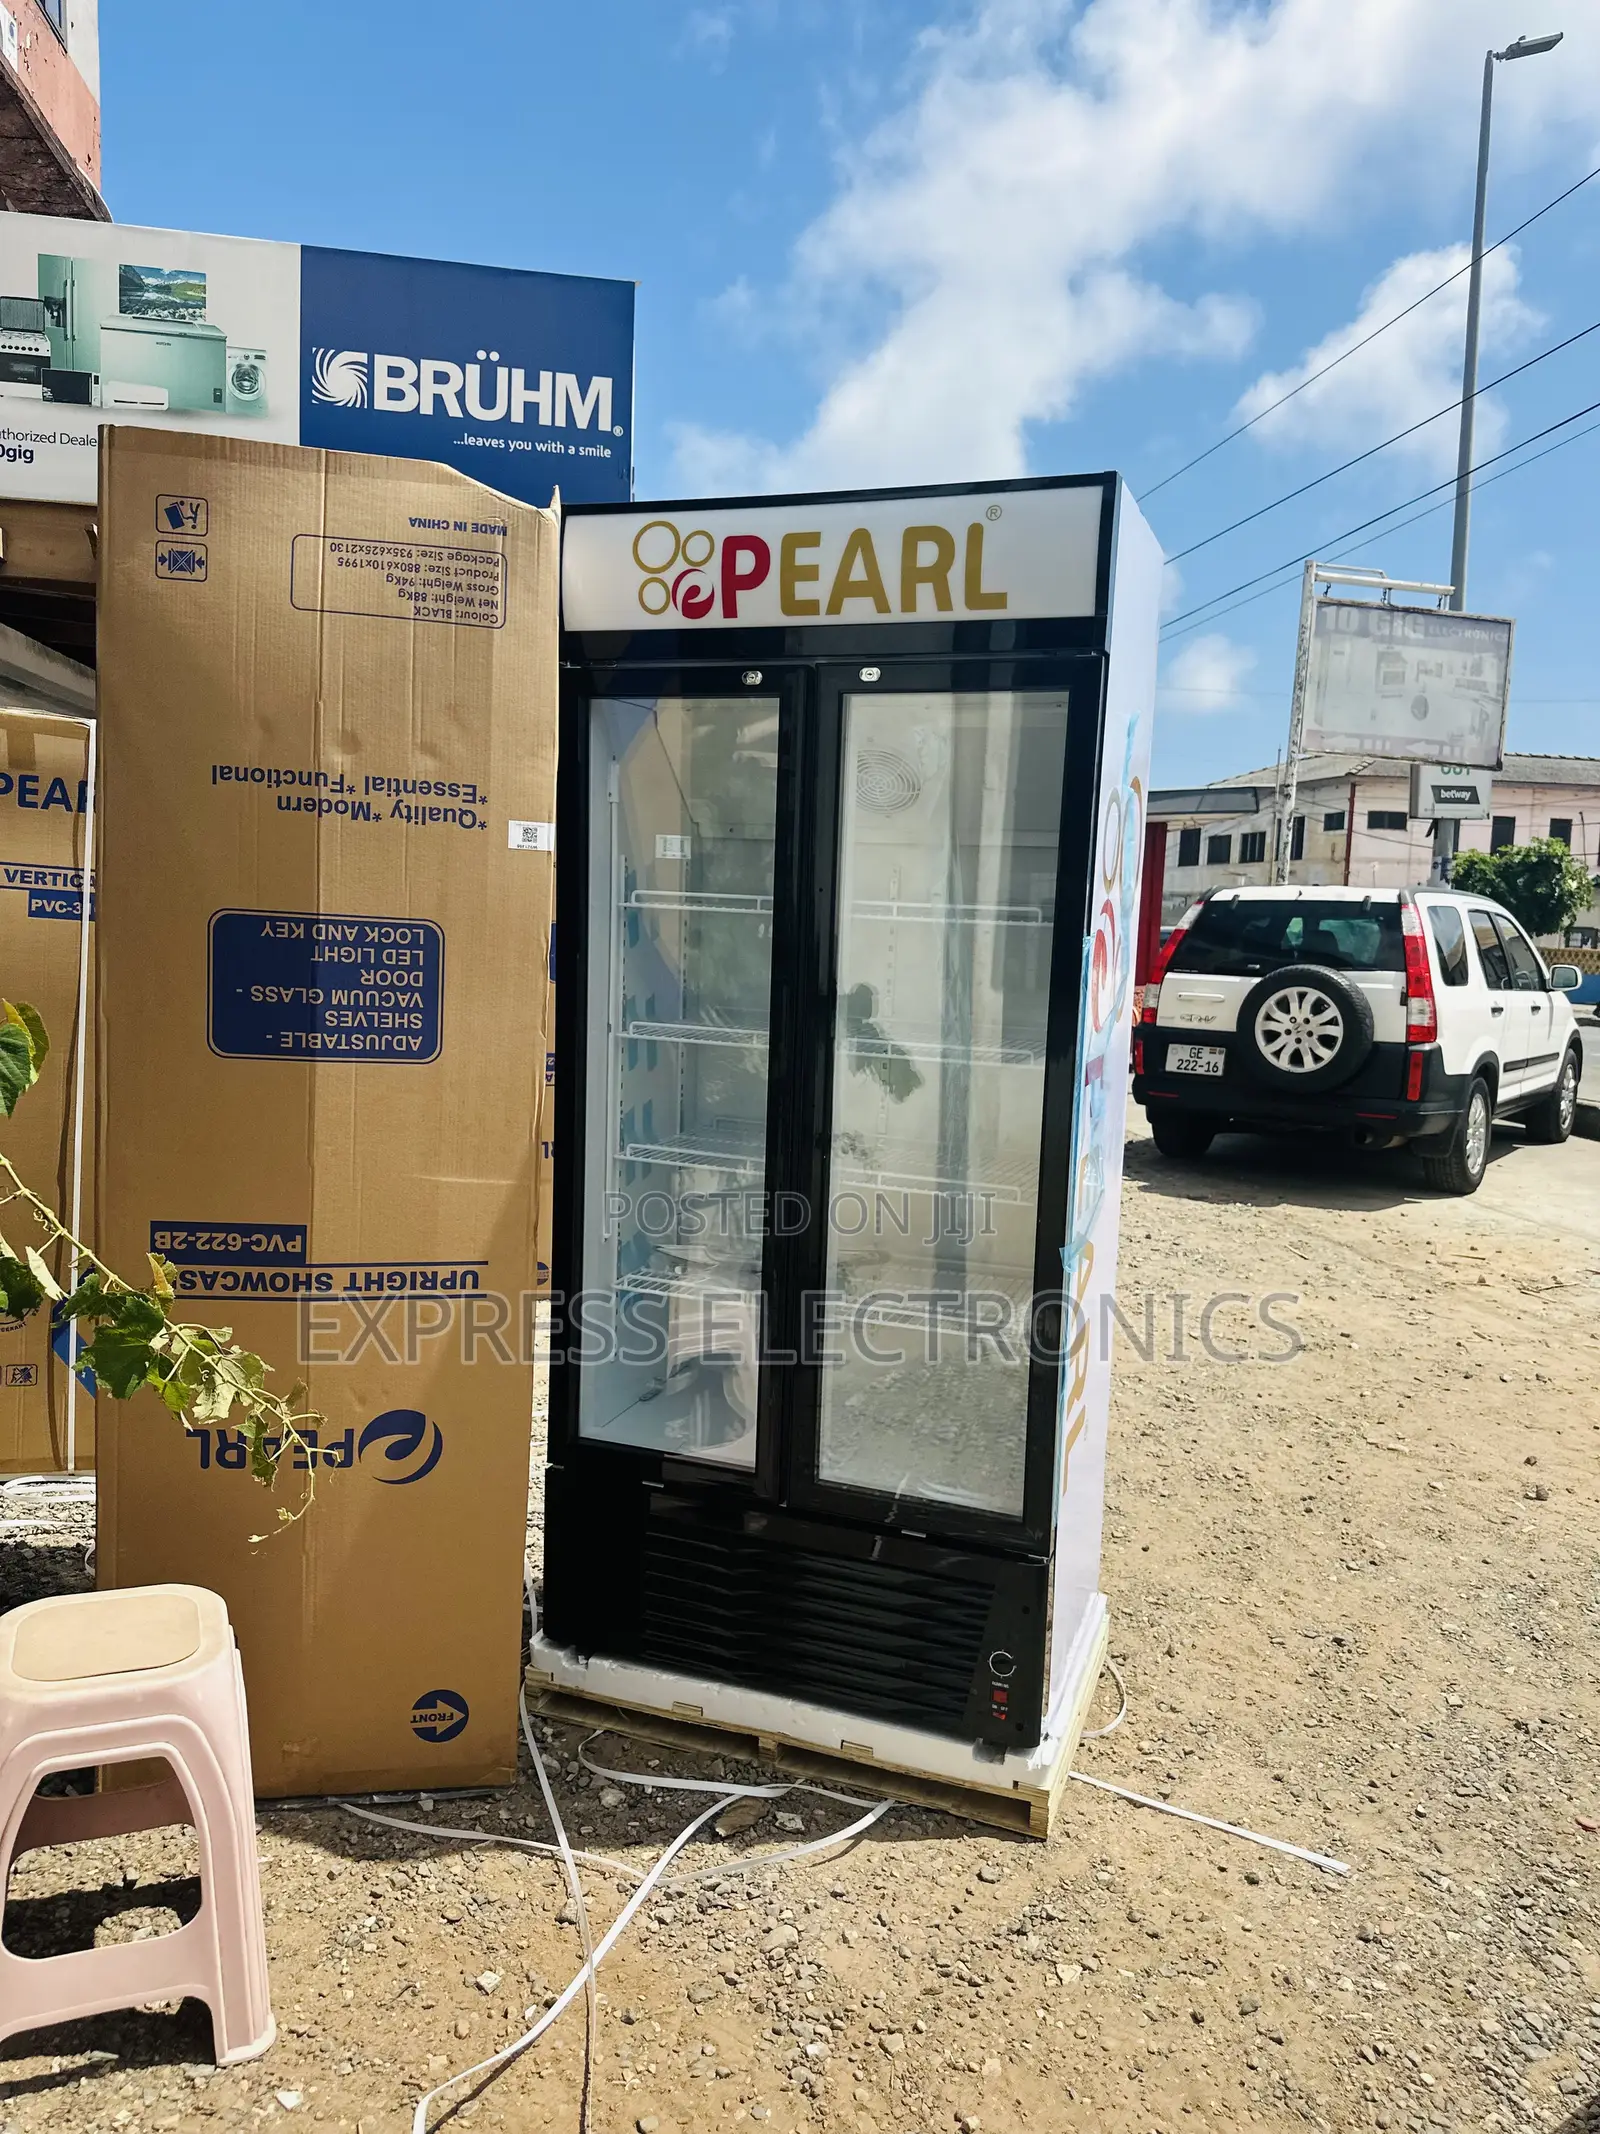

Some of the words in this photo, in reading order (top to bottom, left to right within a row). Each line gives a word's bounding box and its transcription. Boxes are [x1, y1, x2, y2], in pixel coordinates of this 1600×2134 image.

[60, 432, 97, 447] Deale
[509, 440, 531, 452] you
[535, 440, 564, 453] with
[568, 446, 575, 454] a
[579, 445, 611, 457] smile
[408, 517, 450, 530] CHINA
[453, 521, 467, 532] IN
[472, 523, 508, 536] MADE
[330, 542, 413, 558] 935x625x2130
[417, 550, 443, 561] Size:
[337, 557, 421, 573] 880x610x1995
[447, 552, 500, 567] Package
[424, 564, 450, 576] Size:
[454, 566, 500, 581] Product
[721, 522, 1008, 619] PEARL
[386, 573, 415, 586] 94Kg
[419, 578, 463, 591] Weight:
[398, 588, 428, 602] 88Kg
[467, 585, 499, 595] Gross
[431, 592, 476, 608] Weight:
[479, 599, 499, 609] Net
[413, 606, 452, 619] BLACK
[455, 610, 498, 624] Colour:
[261, 921, 304, 939] KEY
[312, 924, 358, 941] AND
[365, 927, 424, 945] LOCK
[311, 946, 375, 963] LIGHT
[382, 950, 424, 965] LED
[360, 969, 423, 987] DOOR
[250, 985, 324, 1004] GLASS
[332, 989, 424, 1008] VACUUM
[325, 1011, 423, 1029] SHELVES
[280, 1032, 423, 1051] ADJUSTABLE
[1189, 1047, 1204, 1059] GE
[1177, 1059, 1219, 1073] 222-16
[154, 1231, 302, 1253] PVC-622-2B
[174, 1270, 333, 1293] SHOWCAS
[343, 1270, 479, 1292] UPRIGHT
[410, 1712, 453, 1723] FRONT
